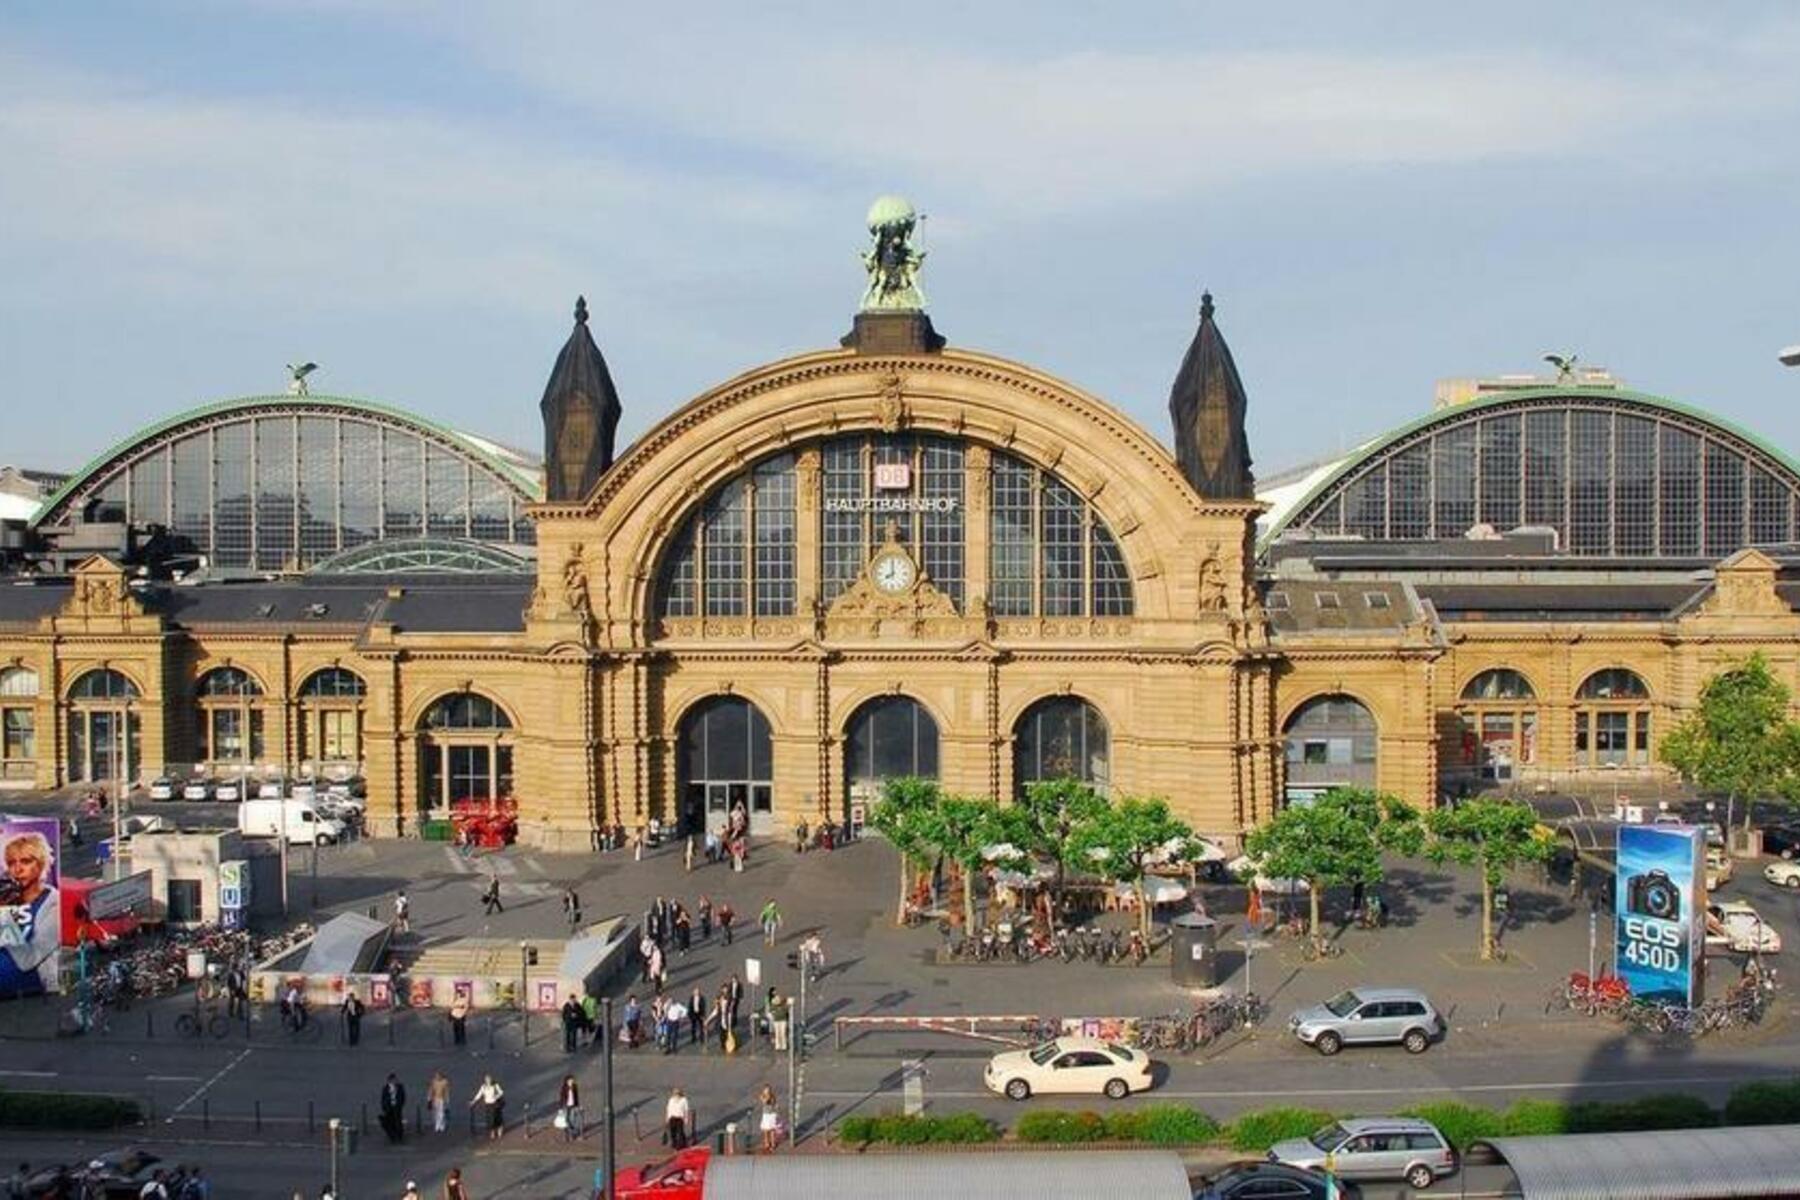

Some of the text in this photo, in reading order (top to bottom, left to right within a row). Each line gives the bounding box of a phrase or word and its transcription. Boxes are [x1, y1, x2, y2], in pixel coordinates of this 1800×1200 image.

[879, 467, 905, 484] DB
[826, 497, 959, 512] HAUPTBAHNHOF
[223, 868, 238, 883] S
[224, 888, 236, 905] U
[1625, 918, 1681, 949] EOS
[1625, 941, 1680, 973] 450D
